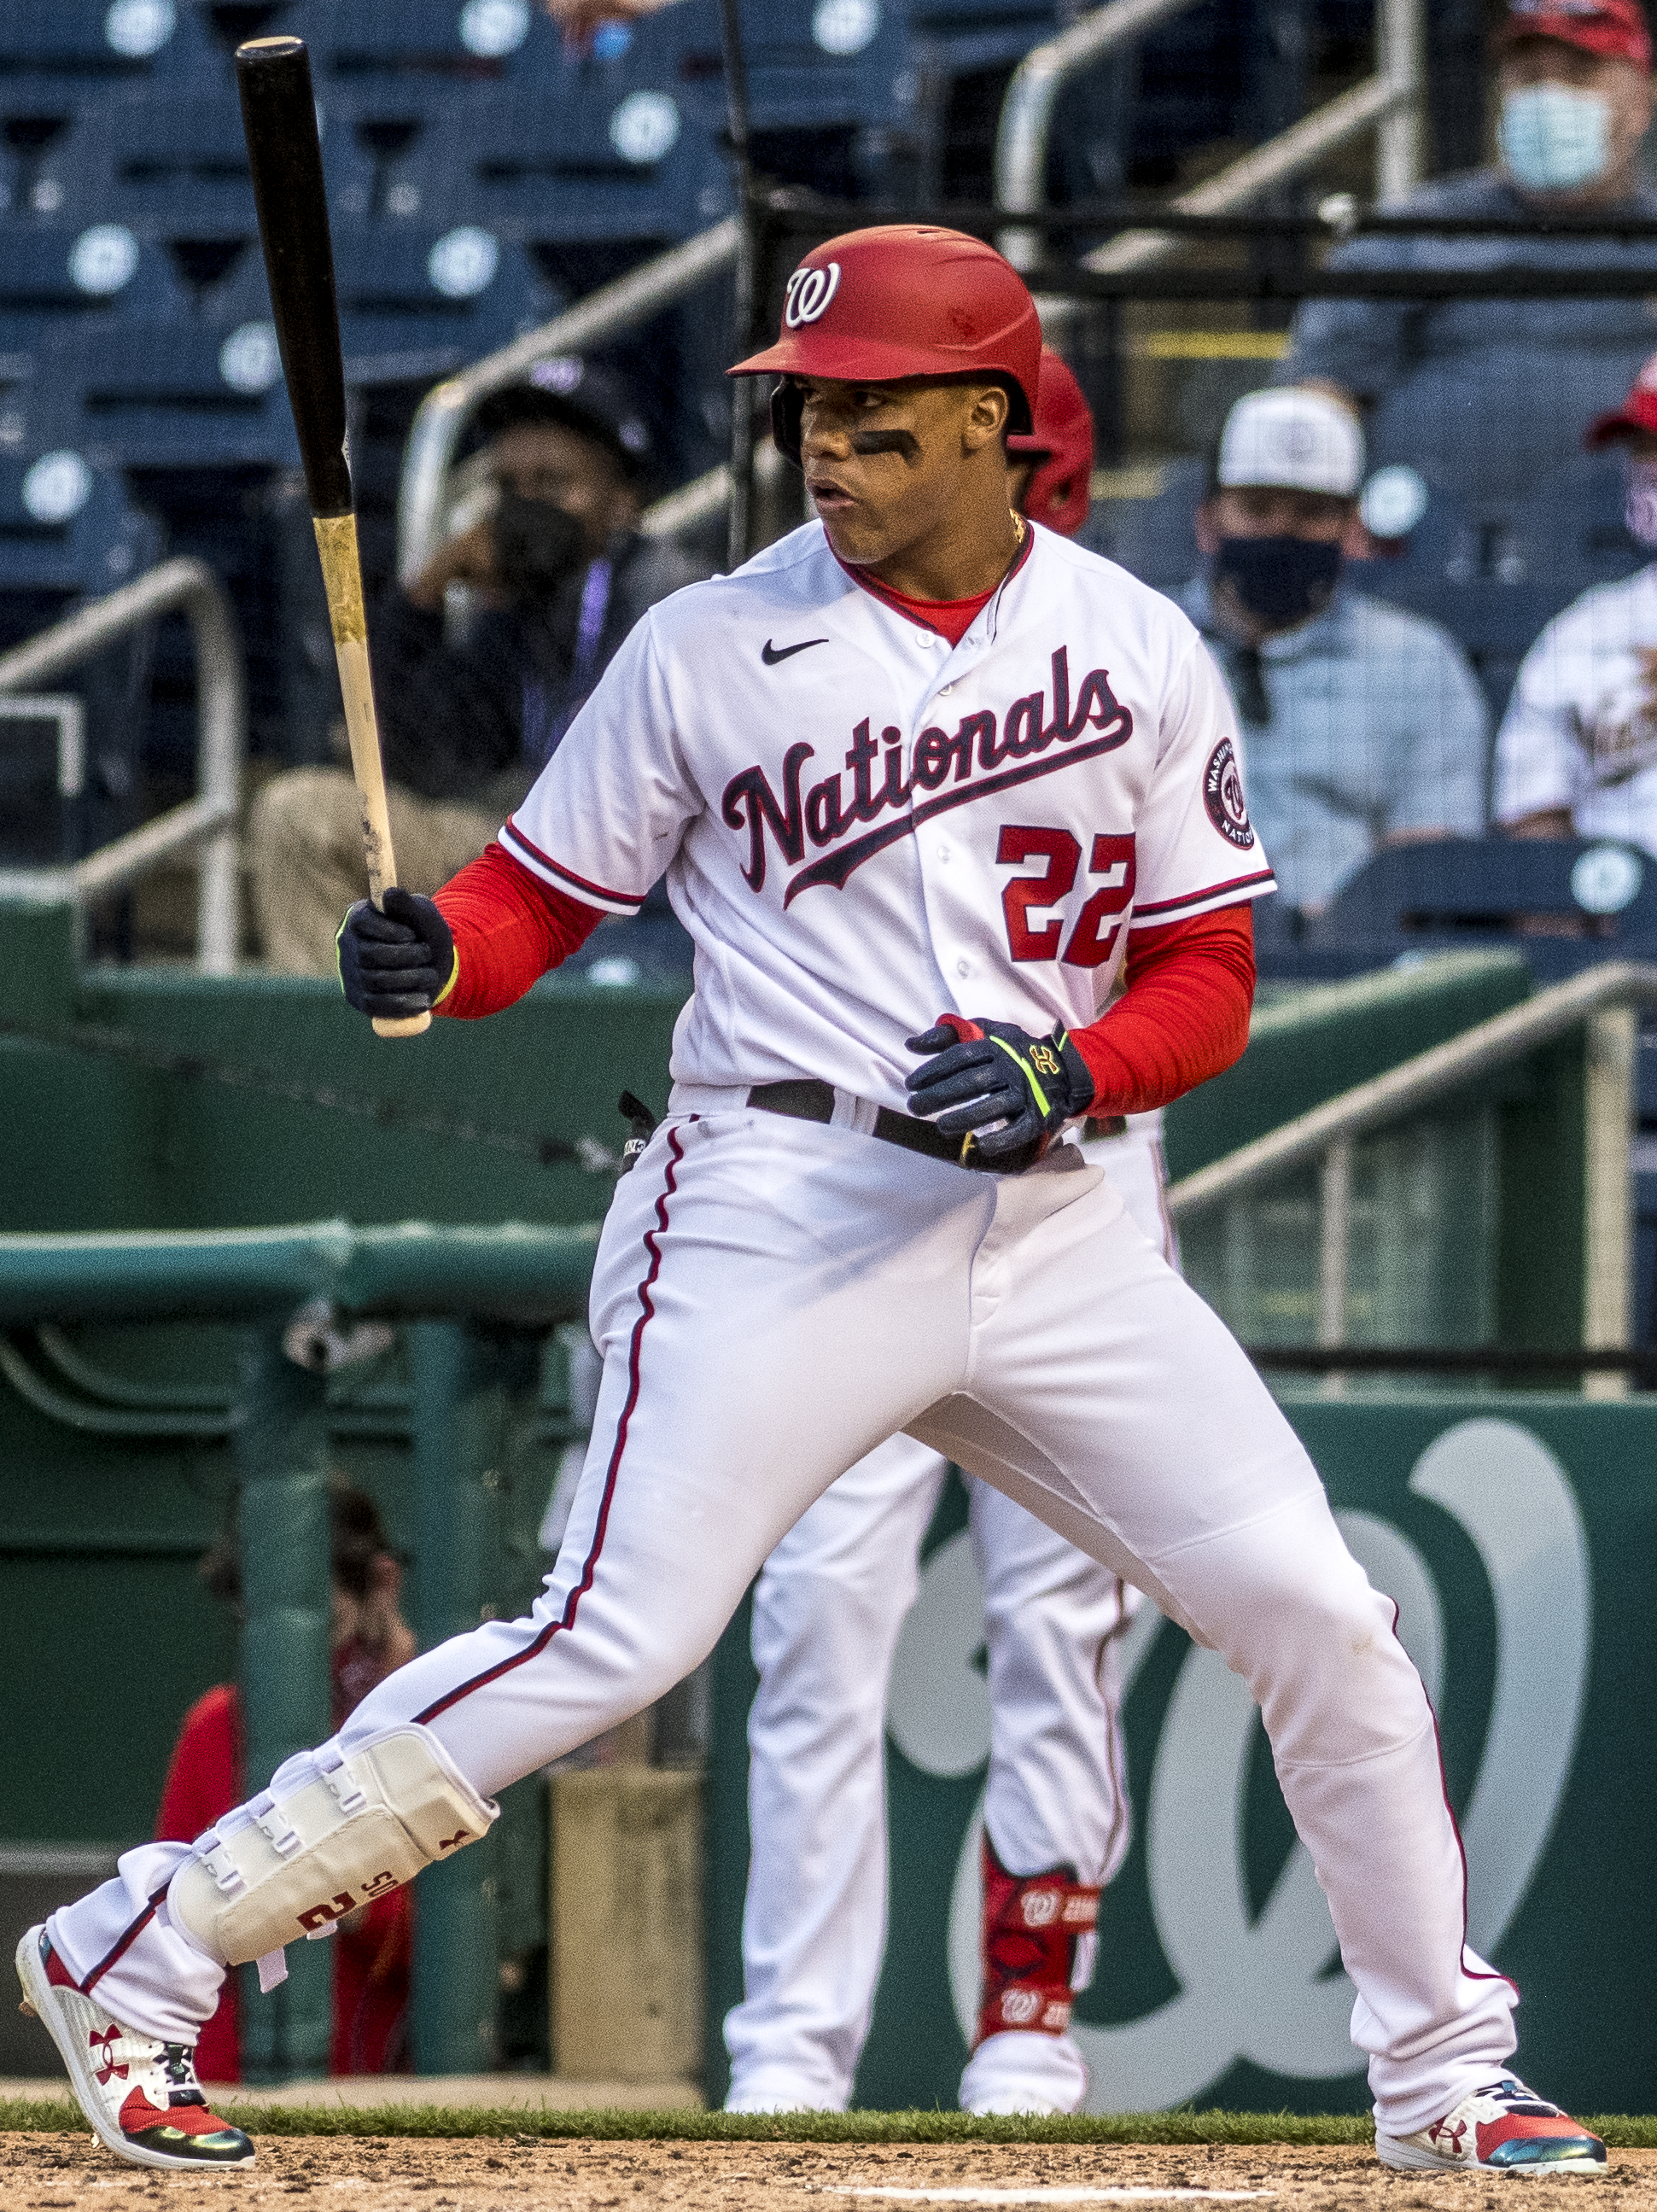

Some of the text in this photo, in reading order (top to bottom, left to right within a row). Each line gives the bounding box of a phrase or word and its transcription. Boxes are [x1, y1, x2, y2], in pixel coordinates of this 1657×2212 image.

[785, 261, 842, 329] W
[721, 644, 1133, 894] Nationals
[995, 824, 1137, 969] 22
